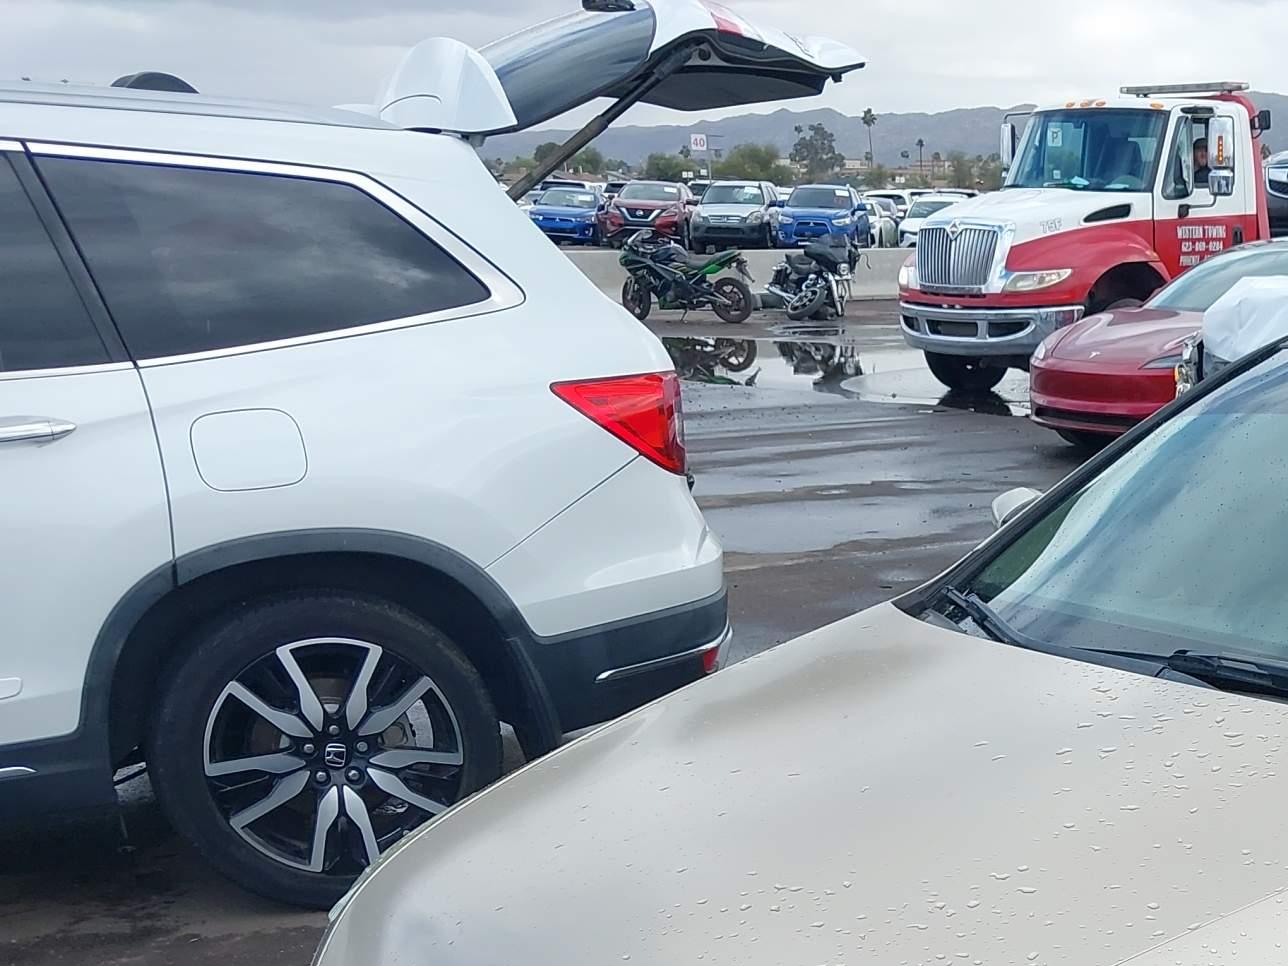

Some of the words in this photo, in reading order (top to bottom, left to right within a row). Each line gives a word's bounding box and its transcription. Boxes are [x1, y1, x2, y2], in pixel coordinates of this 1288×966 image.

[692, 137, 705, 148] 40
[1176, 225, 1203, 239] WESTERN
[1204, 224, 1227, 239] TOWING
